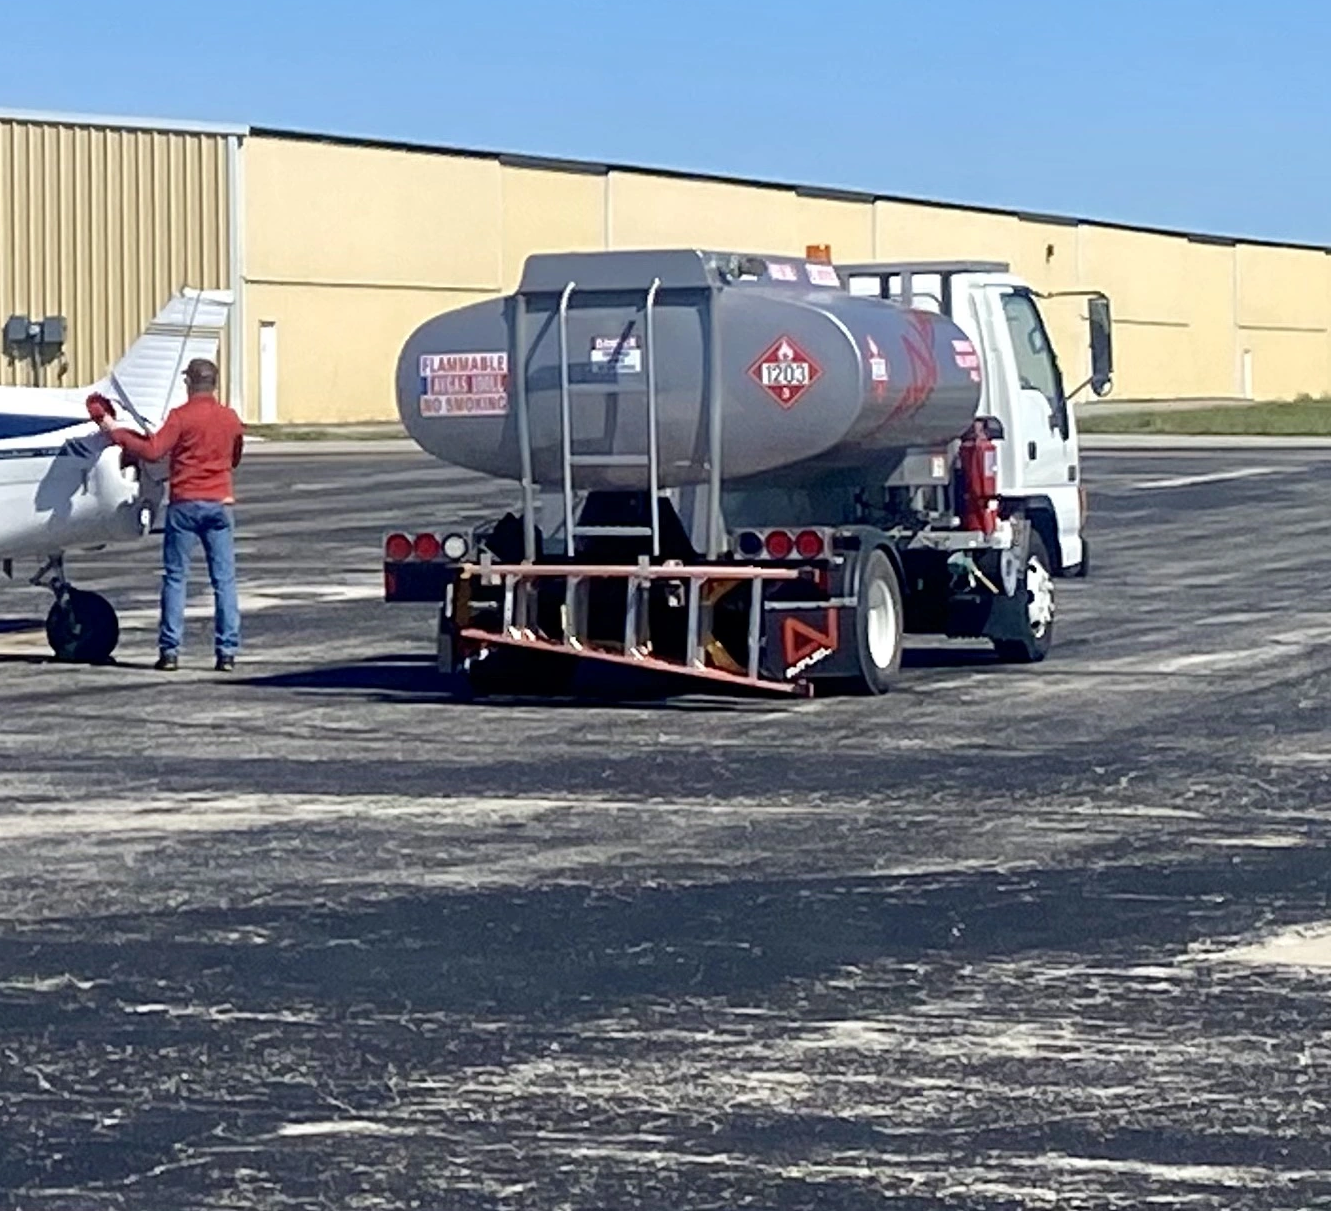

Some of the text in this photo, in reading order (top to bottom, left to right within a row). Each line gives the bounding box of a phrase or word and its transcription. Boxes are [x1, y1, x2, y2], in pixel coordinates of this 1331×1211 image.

[421, 355, 505, 373] FLAMMABLE
[765, 364, 806, 384] 1203
[422, 394, 507, 414] NO SMOKING
